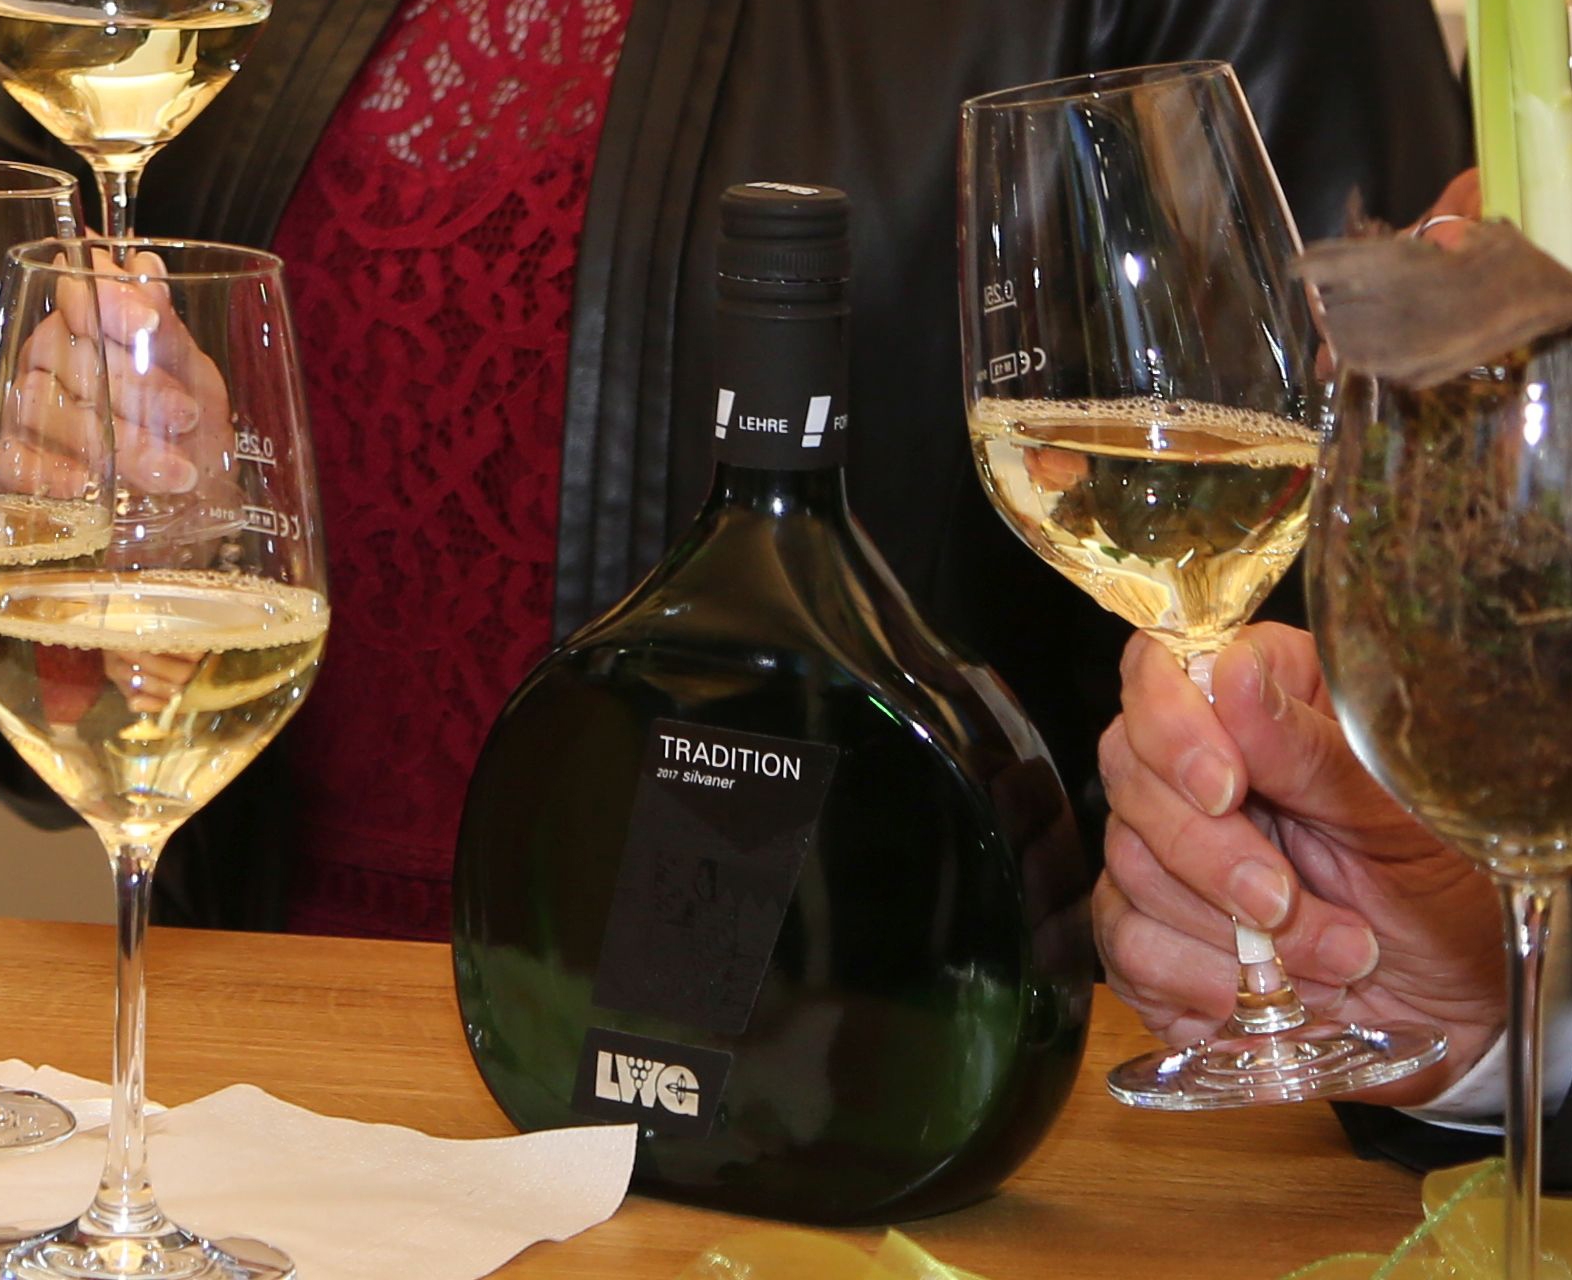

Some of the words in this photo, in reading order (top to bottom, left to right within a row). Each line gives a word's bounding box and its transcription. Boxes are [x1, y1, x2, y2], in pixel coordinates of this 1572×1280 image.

[738, 415, 789, 434] LEHRE
[659, 735, 801, 781] TRADITION
[656, 767, 679, 781] 2017
[682, 769, 736, 790] silvaner
[595, 1050, 700, 1117] LWG
